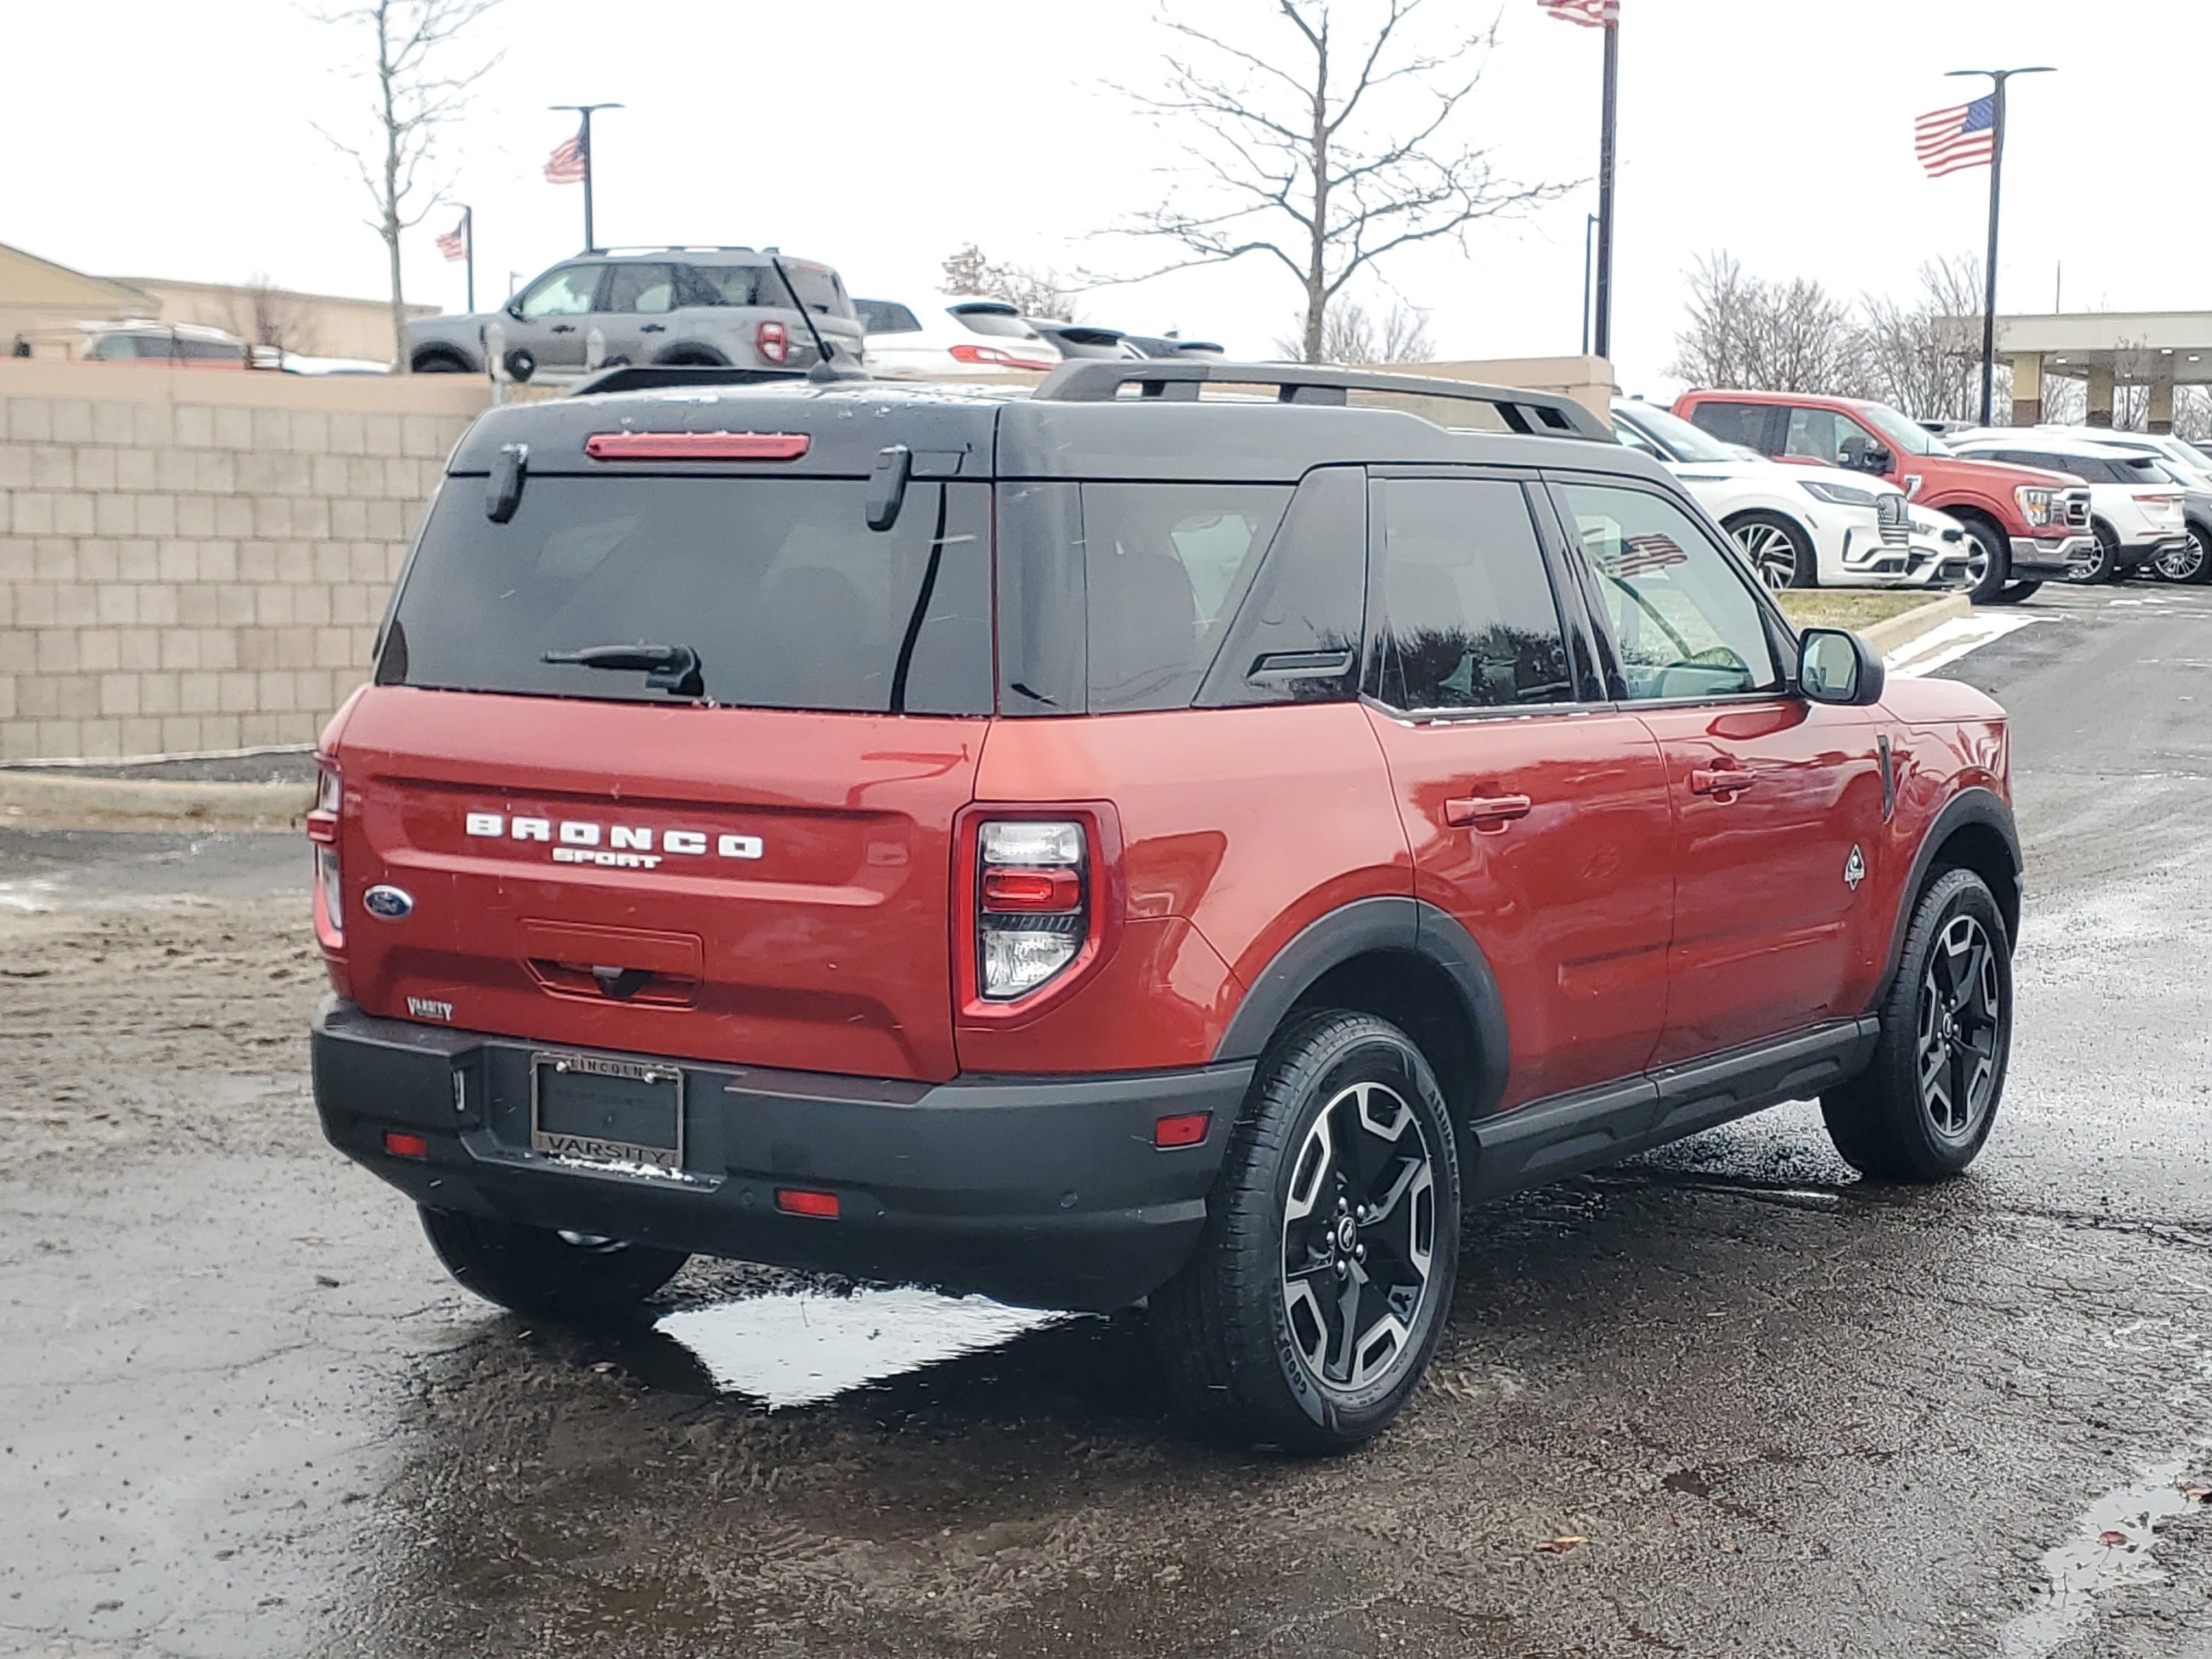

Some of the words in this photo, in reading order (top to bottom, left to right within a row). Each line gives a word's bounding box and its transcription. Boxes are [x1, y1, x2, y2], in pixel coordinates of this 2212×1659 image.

[466, 813, 763, 859] BRONCO
[552, 848, 662, 868] SPORT
[571, 1058, 642, 1076] LINCOLN
[548, 1136, 666, 1164] VARSITY
